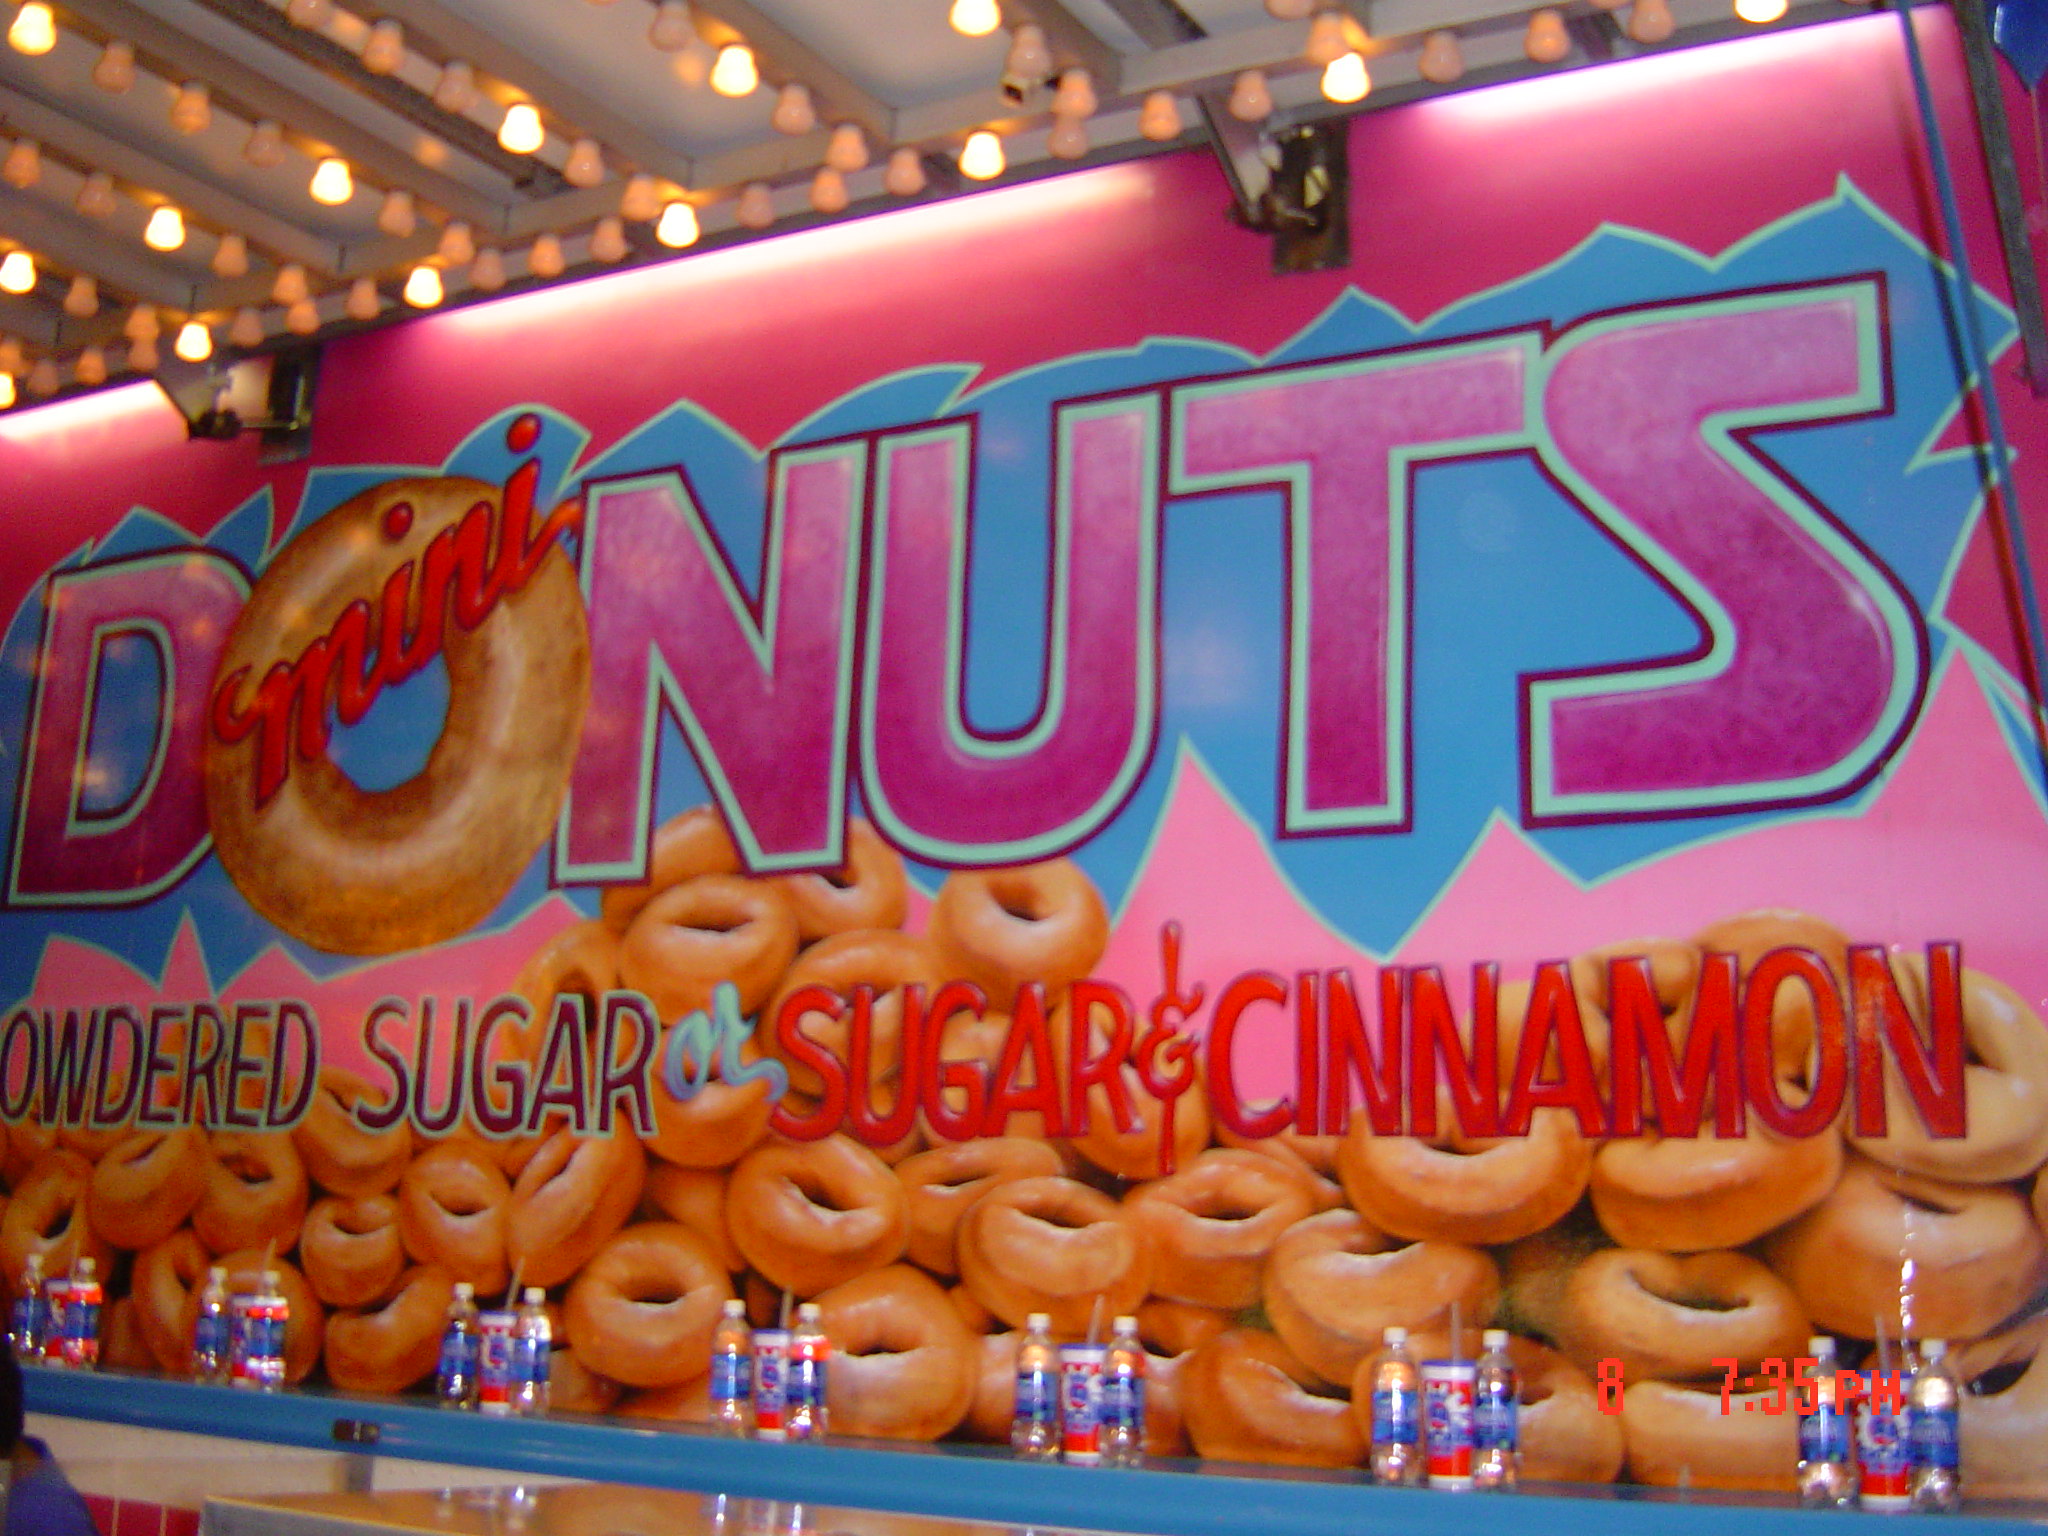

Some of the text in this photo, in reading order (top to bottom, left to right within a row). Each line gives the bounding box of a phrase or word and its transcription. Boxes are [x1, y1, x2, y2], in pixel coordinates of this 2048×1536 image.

[3, 270, 1931, 955] DONUTS
[211, 411, 586, 812] mini
[350, 989, 662, 1139] SUGAR
[663, 981, 790, 1102] or
[768, 979, 1146, 1148] SUGAR
[1205, 938, 1970, 1142] CINNAMON
